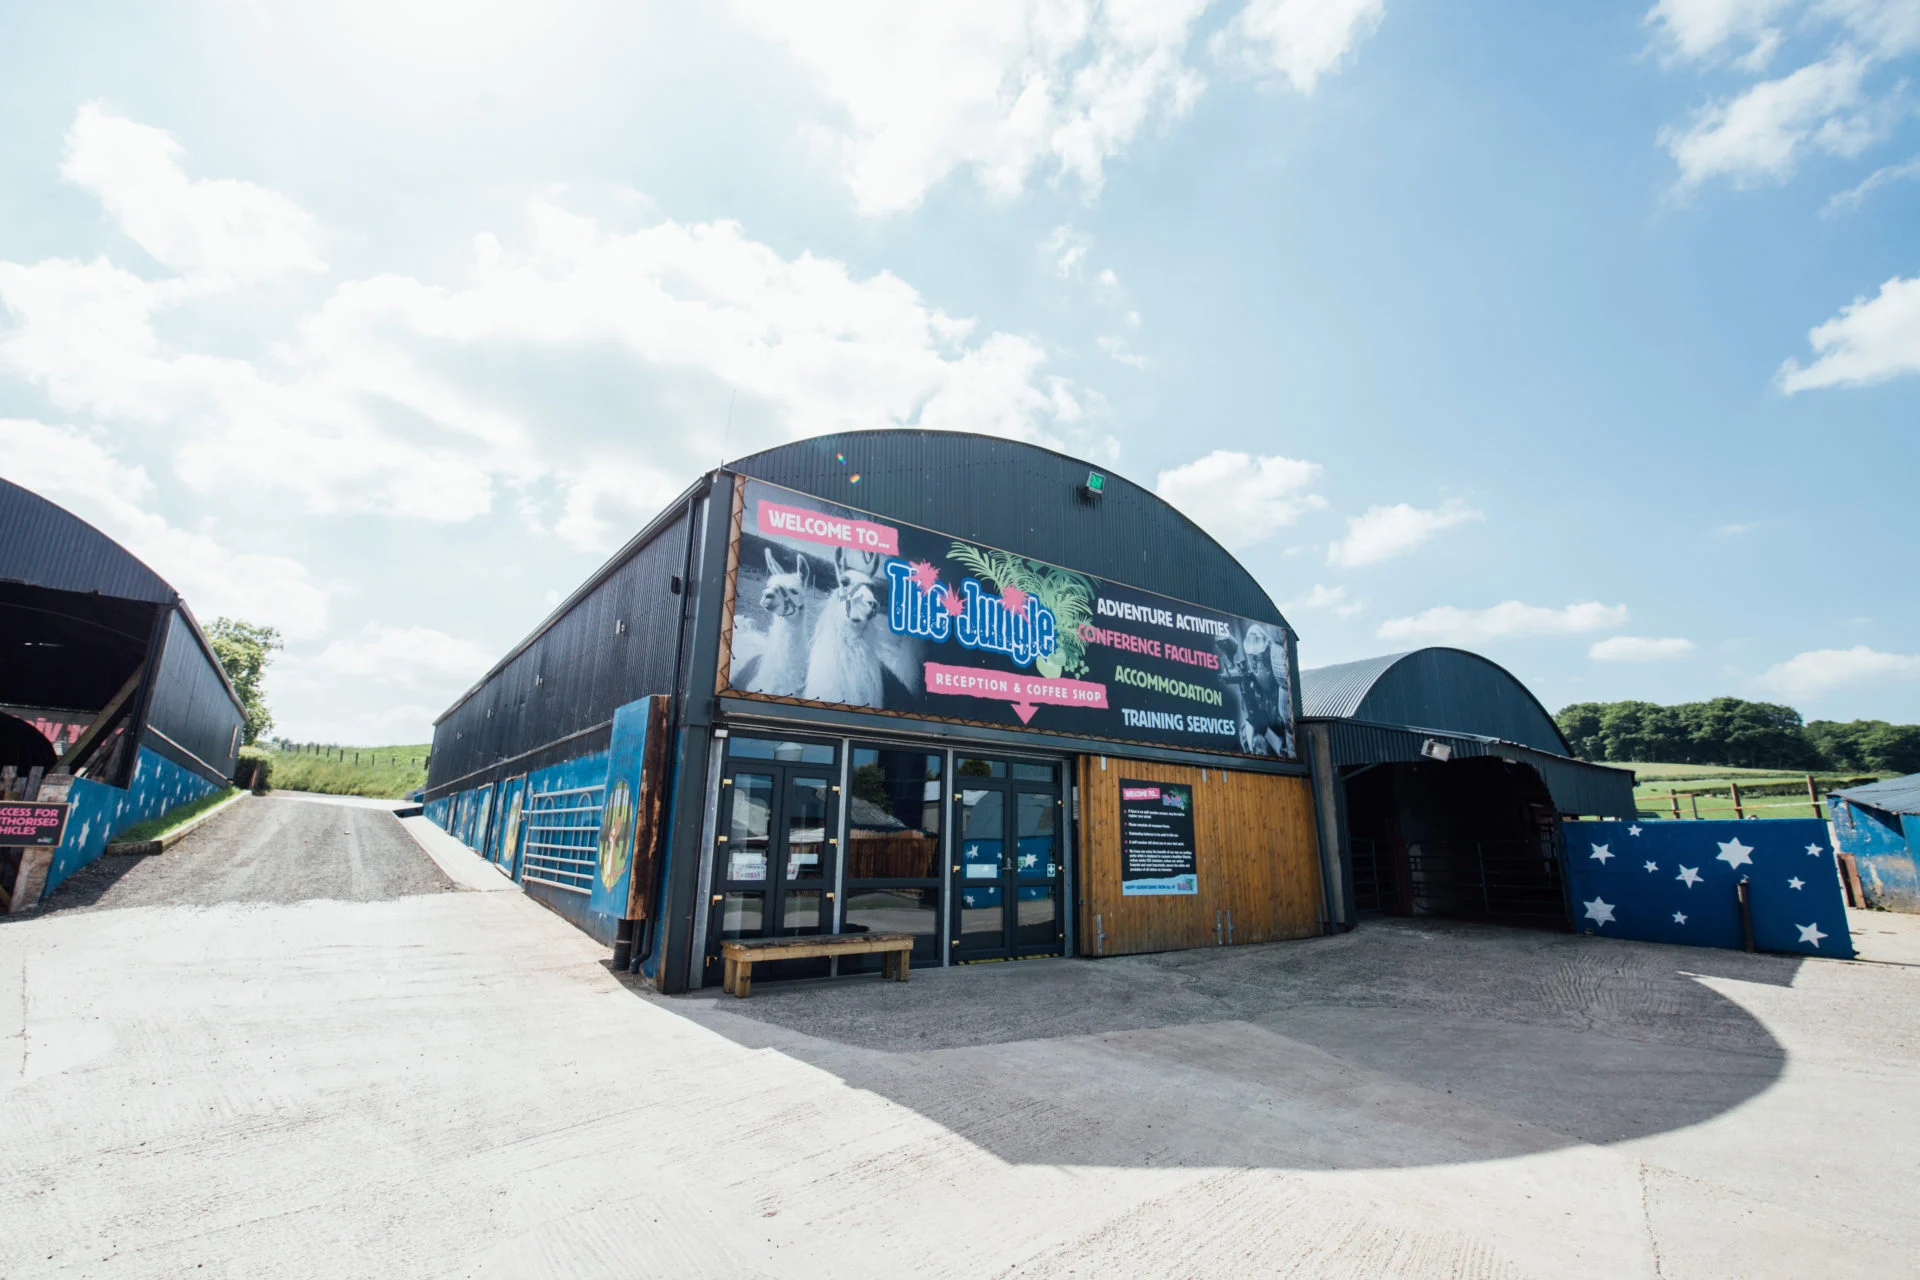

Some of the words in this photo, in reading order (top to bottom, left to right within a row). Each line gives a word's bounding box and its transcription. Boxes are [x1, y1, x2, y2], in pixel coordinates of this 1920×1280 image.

[768, 509, 852, 542] WELCOME
[855, 526, 890, 549] TO...
[885, 559, 951, 641] The
[956, 577, 1056, 666] Jungle
[1097, 598, 1174, 628] ADVENTURE
[1176, 613, 1230, 637] ACTIVITIES
[1077, 623, 1161, 657] CONFERENCE
[1164, 643, 1220, 670] FACILITIES
[936, 673, 1008, 692] RECEPTION
[1013, 682, 1021, 694] &
[1027, 684, 1068, 699] COFFEE
[1072, 687, 1102, 702] SHOP
[1115, 665, 1222, 707] ACCOMMODATION
[1121, 708, 1184, 731] TRAINING
[1186, 715, 1236, 736] SERVICES
[0, 807, 32, 817] CCESS
[34, 808, 59, 818] FOR
[0, 817, 59, 827] THORISED
[0, 826, 37, 835] HICLES
